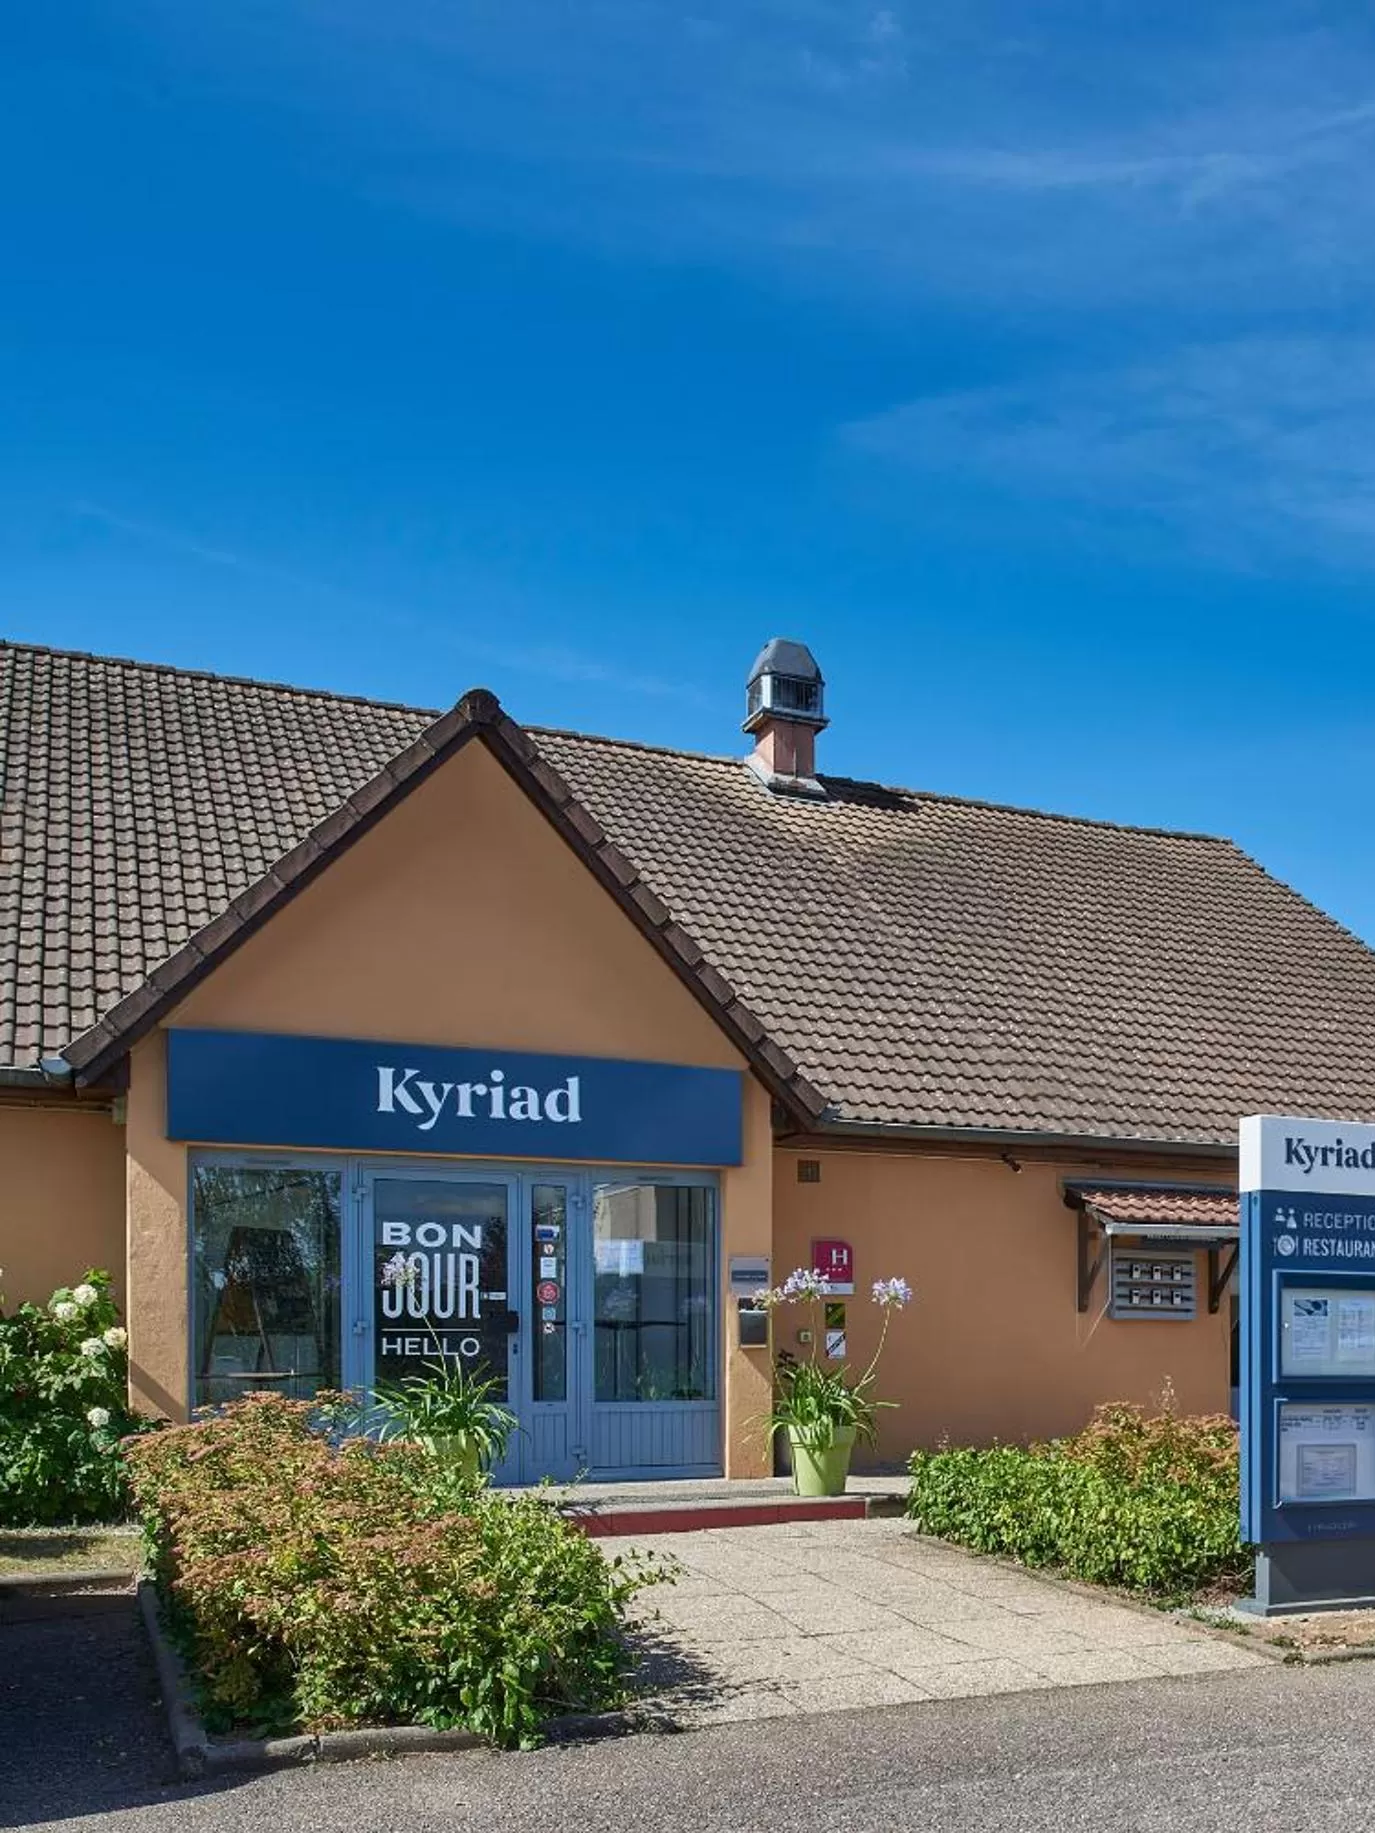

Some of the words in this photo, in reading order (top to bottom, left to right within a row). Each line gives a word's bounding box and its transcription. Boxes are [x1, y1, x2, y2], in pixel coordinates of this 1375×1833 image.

[376, 1066, 582, 1130] Kyriad
[382, 1221, 482, 1249] BON
[831, 1248, 848, 1265] H
[382, 1337, 480, 1357] HELLO
